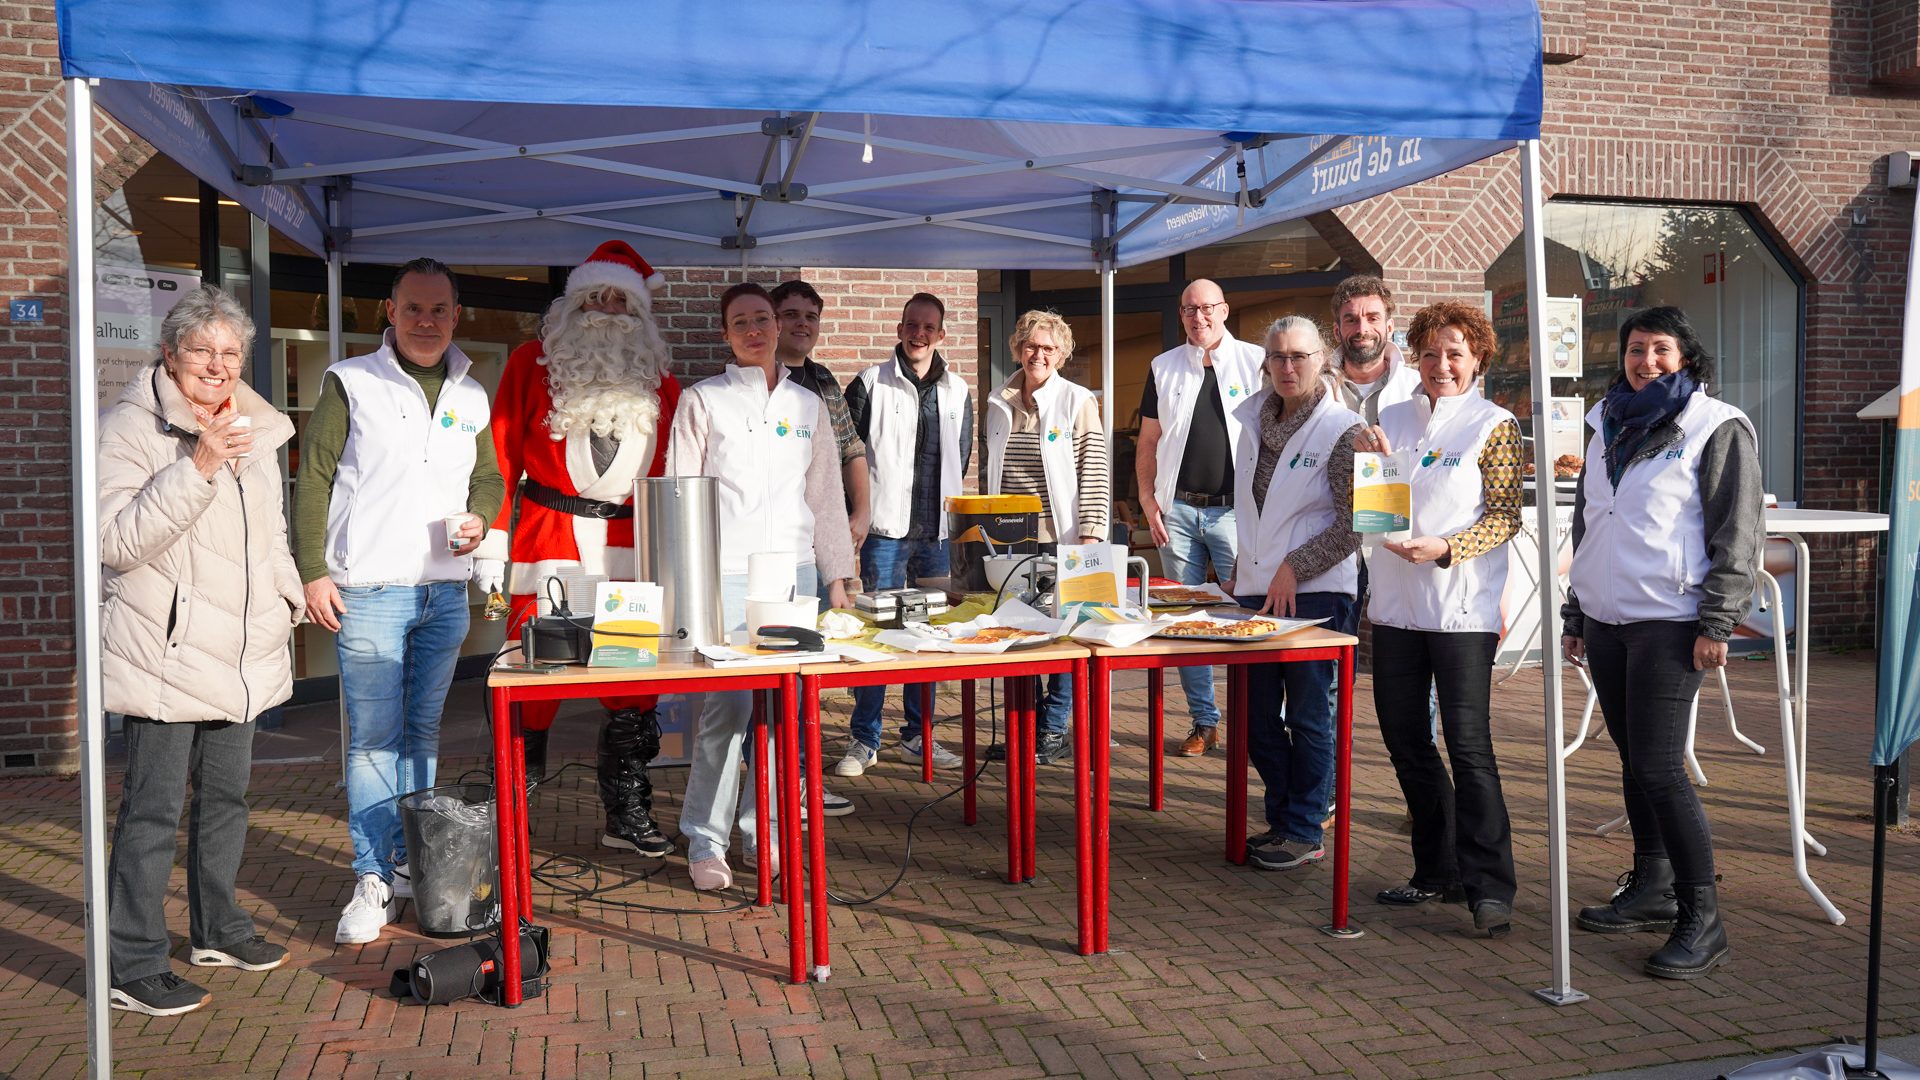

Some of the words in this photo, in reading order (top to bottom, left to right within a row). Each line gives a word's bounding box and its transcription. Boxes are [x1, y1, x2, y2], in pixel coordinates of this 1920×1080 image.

[16, 303, 38, 318] 34
[97, 322, 140, 340] alhuis
[1085, 557, 1103, 568] EIN.
[628, 602, 649, 614] EIN.
